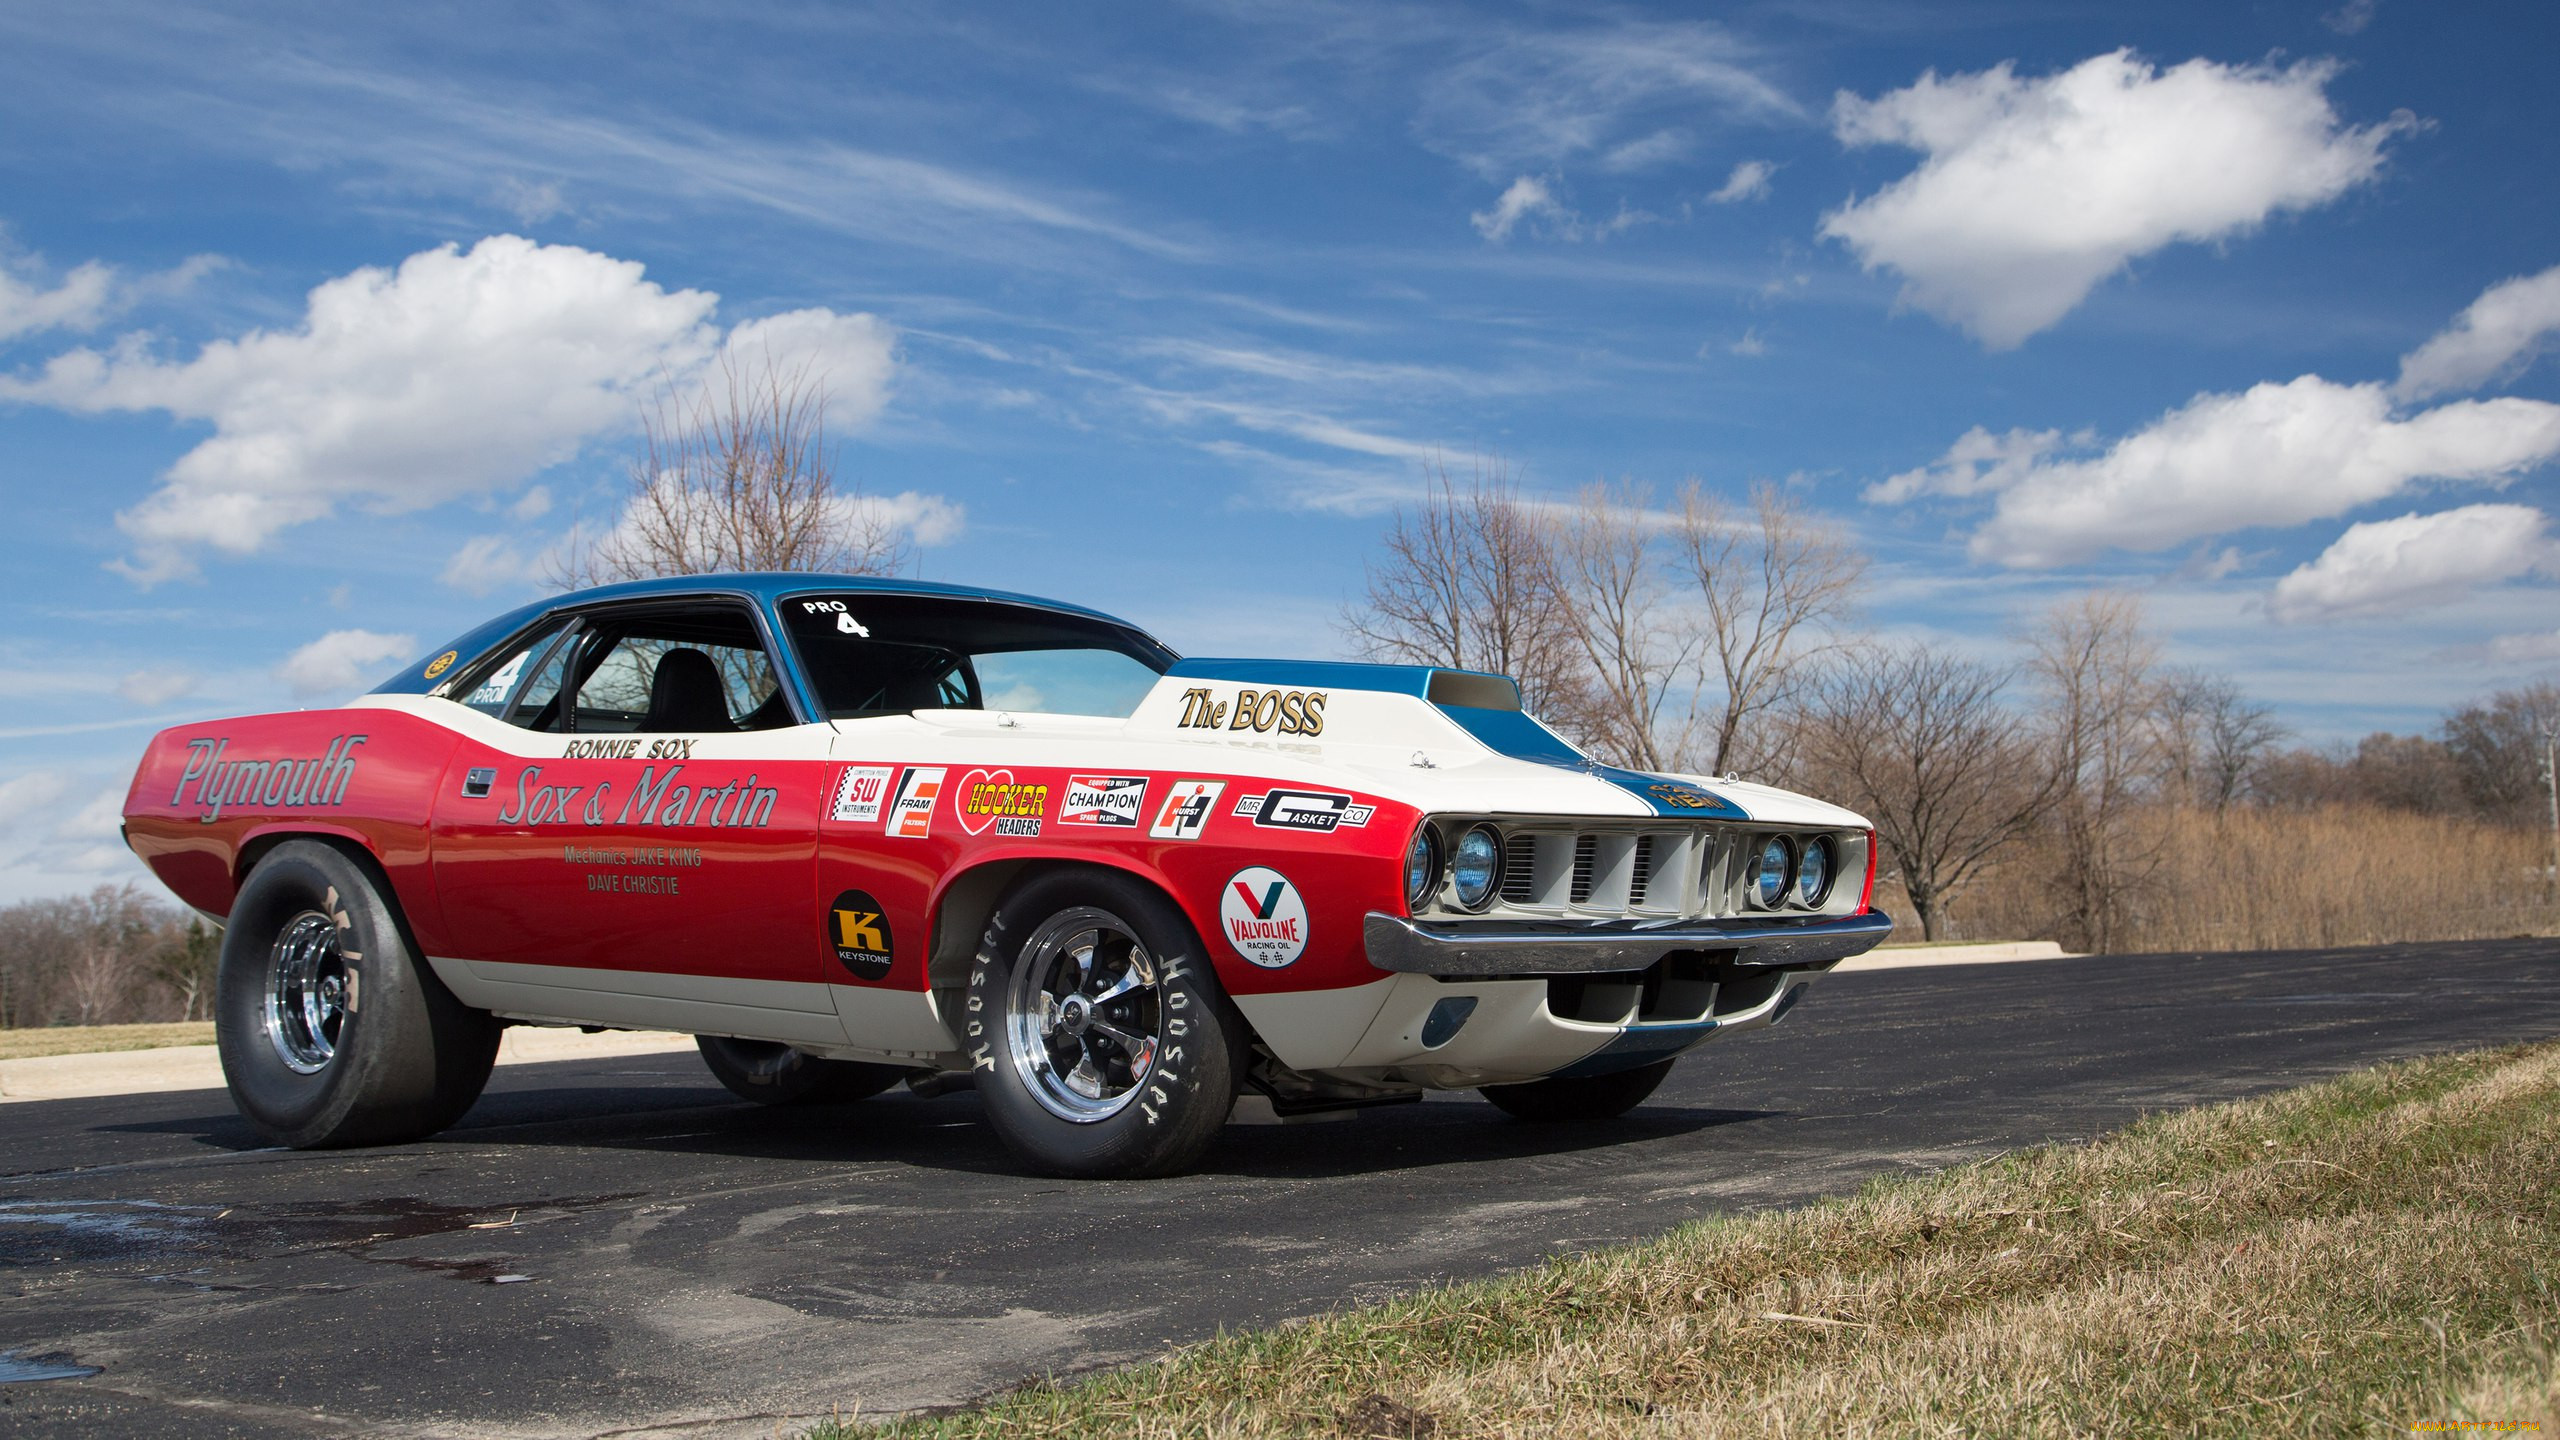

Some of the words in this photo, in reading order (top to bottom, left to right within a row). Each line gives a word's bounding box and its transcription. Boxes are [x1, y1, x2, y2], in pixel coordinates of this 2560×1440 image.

[802, 600, 848, 615] PRO
[837, 612, 870, 638] 4
[489, 650, 531, 702] 4
[473, 687, 502, 704] PRO
[1177, 687, 1227, 730] The
[1228, 689, 1328, 738] BOSS
[562, 738, 642, 760] RONNIE
[646, 738, 699, 760] SOX
[169, 734, 369, 824] Plymouth
[850, 777, 881, 803] SW
[1087, 779, 1115, 787] EQUIPPED
[496, 765, 584, 827] Sox
[583, 781, 611, 827] &
[614, 764, 779, 828] Martin
[899, 798, 931, 810] FRAM
[966, 782, 1049, 817] HOOKER
[1068, 792, 1138, 809] CHAMPION
[841, 803, 878, 814] INSTRUMENTS
[1079, 814, 1098, 822] SPARK
[1098, 815, 1117, 823] PLUGS
[1171, 806, 1201, 816] HURST
[1239, 800, 1261, 812] MR.
[1270, 796, 1342, 826] GASKET
[1343, 809, 1364, 821] CO.
[996, 818, 1041, 837] HEADERS
[564, 845, 627, 866] Mechanics
[630, 847, 665, 866] JAKE
[668, 847, 702, 868] KING
[587, 873, 620, 893] DAVE
[622, 875, 680, 895] CHRISTIE
[833, 909, 889, 952] K
[1230, 917, 1300, 943] VALVOLINE
[1246, 942, 1276, 950] RACING
[1277, 942, 1291, 950] OIL
[838, 950, 892, 965] KEYSTONE
